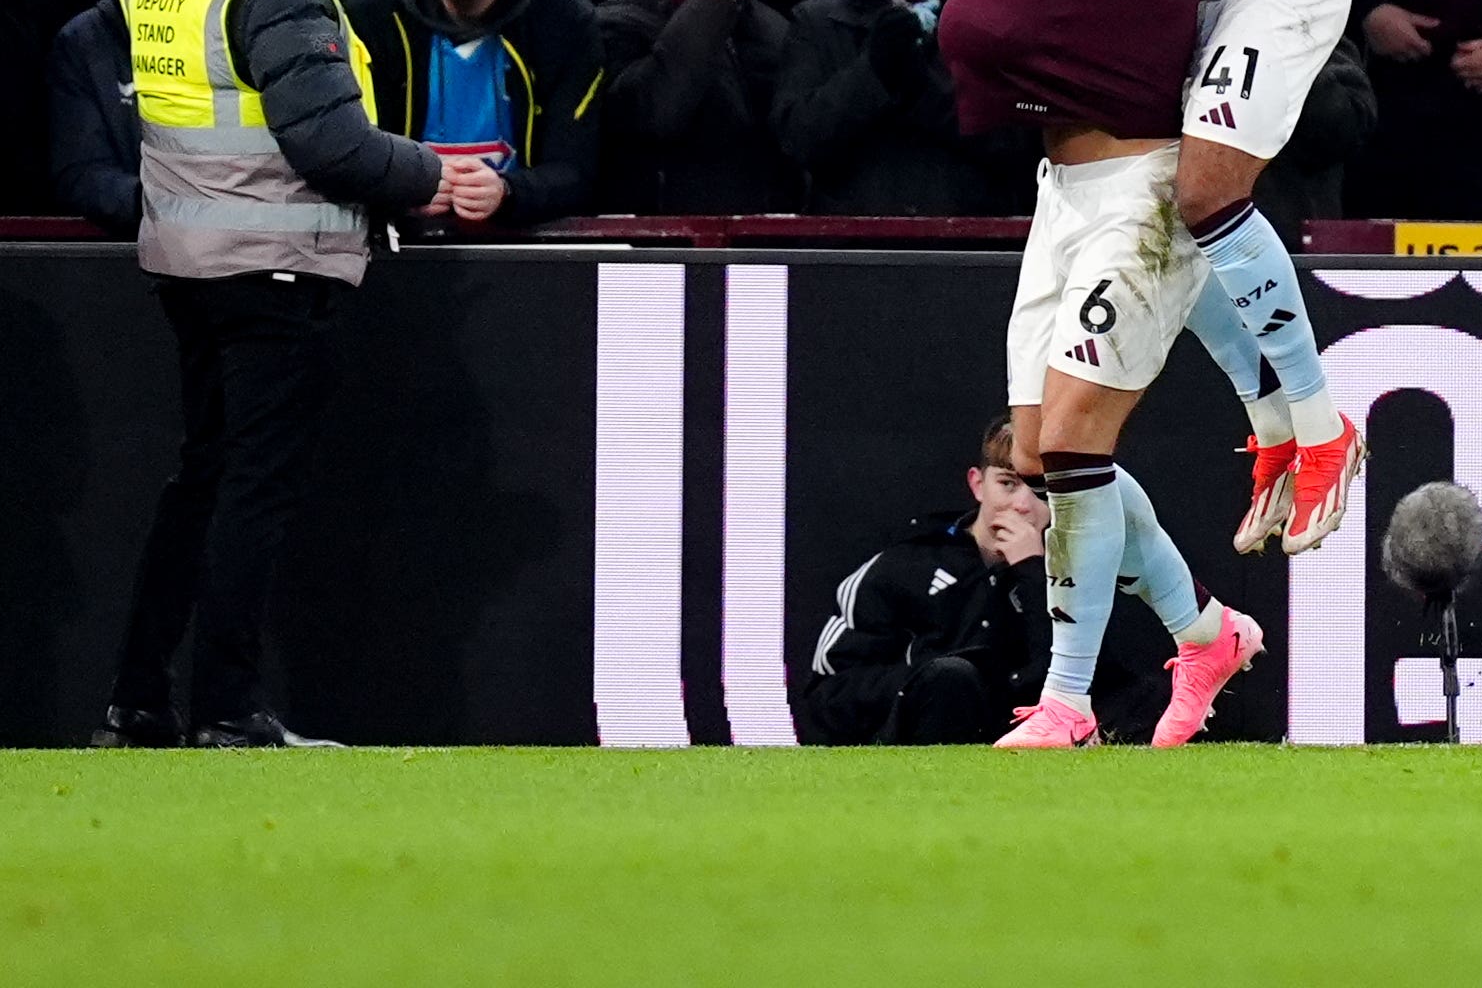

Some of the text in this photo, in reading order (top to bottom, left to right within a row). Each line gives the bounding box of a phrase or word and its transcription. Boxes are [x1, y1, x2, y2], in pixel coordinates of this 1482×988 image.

[137, 23, 175, 43] STAND
[1201, 44, 1259, 100] 41
[1079, 278, 1117, 334] 6
